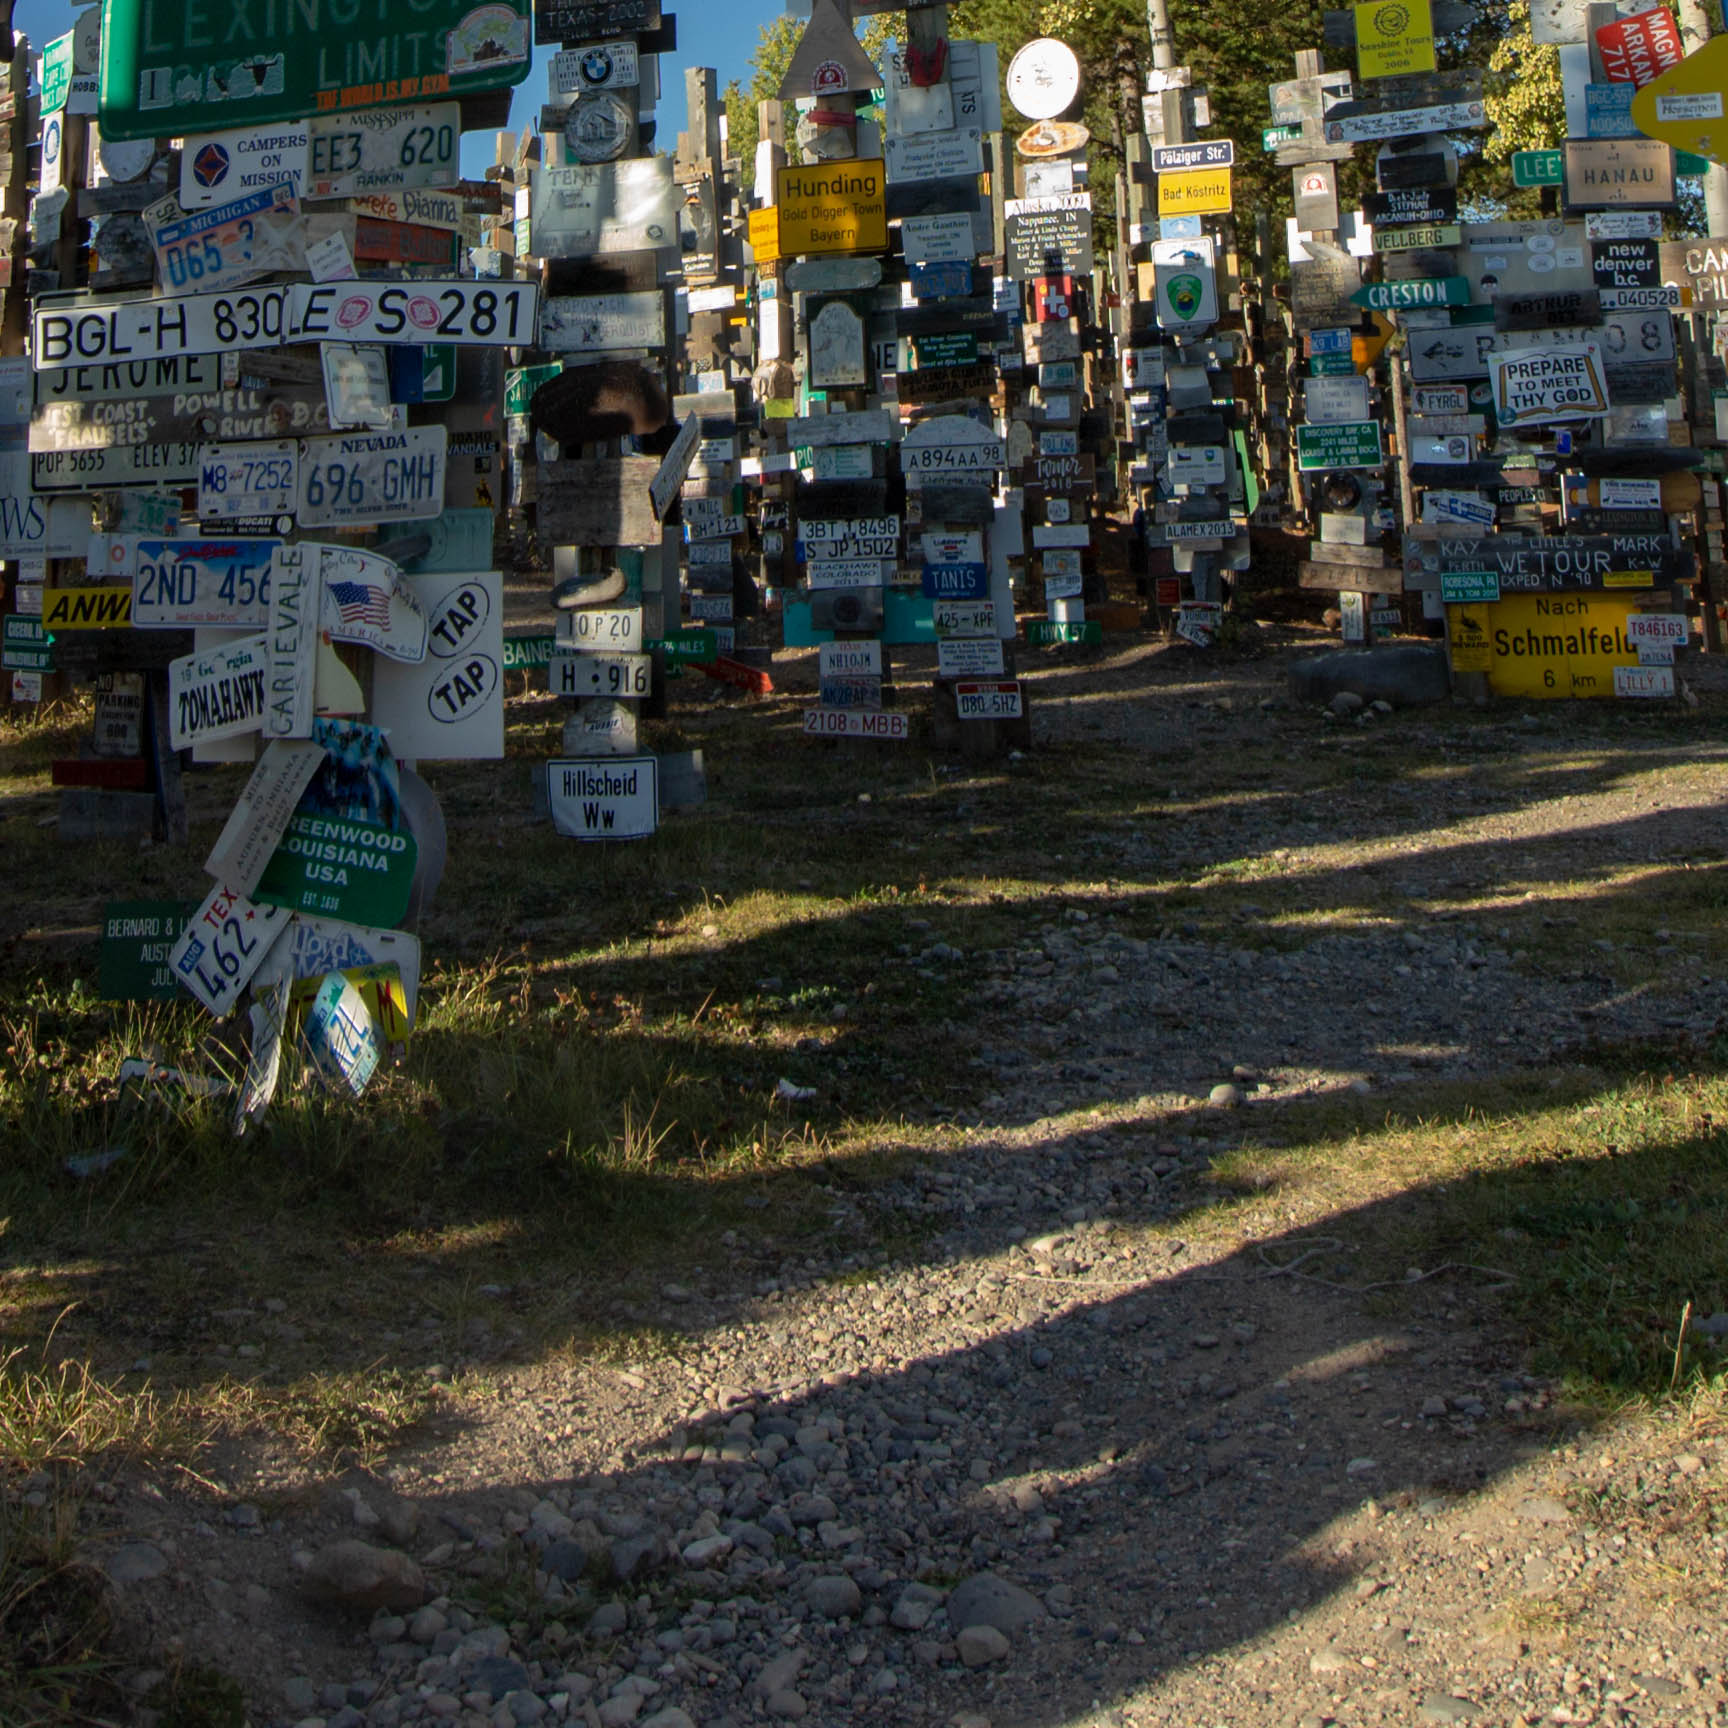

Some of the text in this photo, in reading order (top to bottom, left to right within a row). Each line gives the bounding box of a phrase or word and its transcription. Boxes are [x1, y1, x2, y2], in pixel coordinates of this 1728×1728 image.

[237, 133, 308, 153] CAMPERS
[312, 123, 454, 173] EE3 620
[260, 153, 283, 167] ON
[785, 174, 877, 199] Hunding
[1584, 167, 1655, 185] HANAU
[1163, 186, 1182, 200] Bad
[783, 202, 883, 222] Gold Digger Town
[810, 227, 856, 243] Bayern
[1374, 230, 1444, 248] VELLBERG
[1609, 243, 1646, 257] new
[1594, 256, 1654, 272] denver
[1368, 282, 1448, 308] CRESTON
[41, 301, 187, 362] BGL-H
[1507, 357, 1586, 380] PREPARE
[1515, 376, 1581, 392] TO MEET
[1510, 388, 1592, 408] THY GOD
[339, 433, 408, 454] NEVADA
[306, 456, 436, 506] 696 GMH
[432, 591, 478, 643] TAP
[277, 548, 304, 735] CARIEVALE
[435, 661, 486, 717] TAP
[179, 669, 265, 735] TOMAHAWK
[807, 715, 904, 734] 2108 MBB
[562, 767, 638, 798] Hillscheid
[583, 804, 616, 831] Ww
